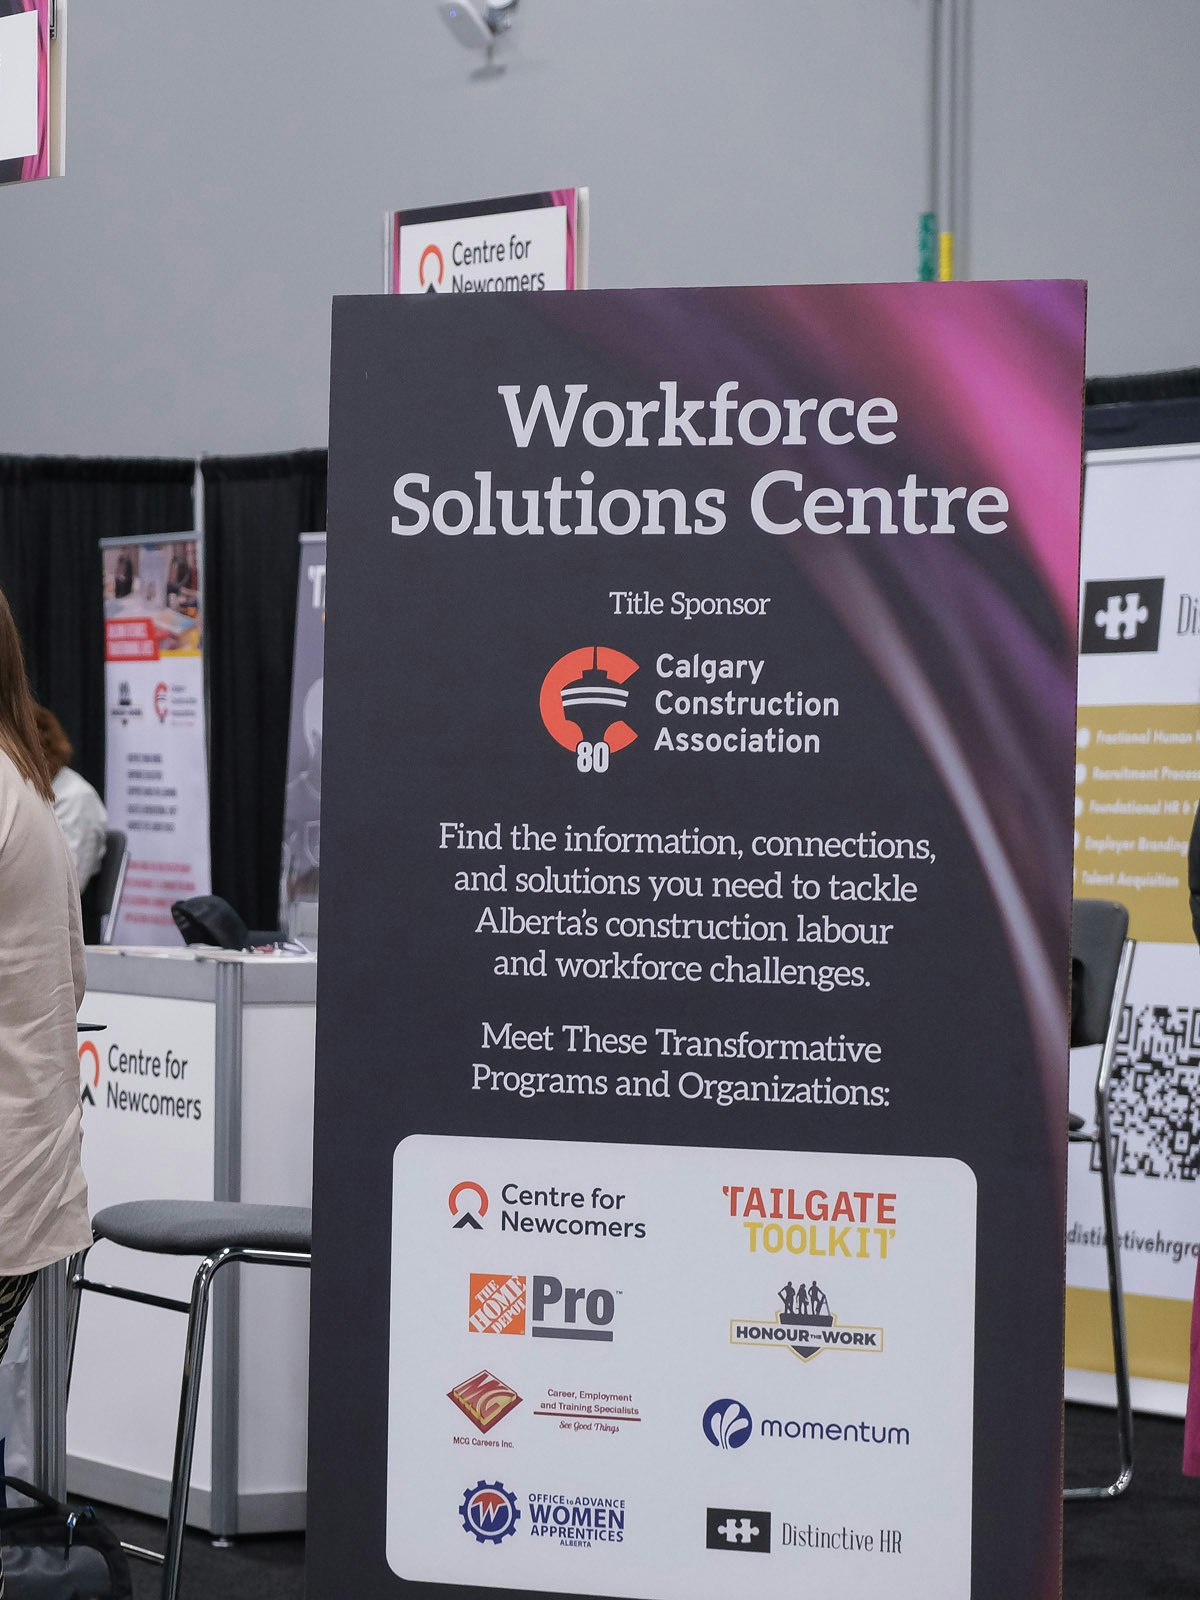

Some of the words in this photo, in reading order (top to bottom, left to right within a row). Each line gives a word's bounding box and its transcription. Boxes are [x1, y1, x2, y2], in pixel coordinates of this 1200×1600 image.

[452, 240, 505, 267] Centre
[509, 234, 532, 260] for
[497, 380, 898, 448] Workforce
[391, 470, 727, 536] Solutions
[750, 469, 1009, 535] Centre
[609, 591, 664, 616] Title
[670, 591, 771, 620] Sponsor
[1177, 593, 1200, 636] Di
[655, 653, 765, 685] Calgary
[655, 689, 839, 717] Construction
[653, 726, 820, 754] Association
[576, 740, 610, 773] 80
[439, 822, 502, 850] Find
[510, 823, 557, 852] the
[564, 824, 744, 861] information,
[751, 830, 937, 865] connections,
[454, 864, 507, 893] and
[515, 866, 641, 896] solutions
[648, 876, 703, 902] you
[711, 871, 783, 899] need
[791, 873, 821, 900] to
[828, 873, 919, 903] tackle
[474, 906, 599, 937] Alberta's
[605, 911, 789, 943] construction
[796, 914, 895, 945] labour
[493, 949, 548, 978] and
[555, 951, 703, 982] workforce
[710, 955, 871, 992] challenges.
[481, 1022, 554, 1051] Meet
[562, 1024, 648, 1055] These
[655, 1028, 883, 1064] Transformative
[107, 1043, 161, 1078] Centre
[165, 1049, 189, 1080] for
[107, 1080, 202, 1121] Newcomers
[471, 1063, 608, 1098] Programs
[615, 1070, 671, 1098] and
[678, 1071, 890, 1107] Organizations:
[501, 1182, 585, 1209] Centre
[591, 1187, 626, 1210] for
[501, 1210, 647, 1239] Newcomers
[1067, 1221, 1200, 1263] distitivehrgro
[469, 1276, 526, 1333] HOME
[474, 1279, 500, 1304] THE
[532, 1275, 615, 1326] Pro
[491, 1297, 526, 1334] DEPOT
[736, 1325, 810, 1343] HONOUR
[822, 1330, 877, 1347] WORK
[540, 1401, 557, 1410] and
[558, 1401, 593, 1413] Training
[594, 1404, 640, 1415] Specialists
[547, 1388, 578, 1400] Career,
[579, 1390, 633, 1402] Employment
[453, 1436, 470, 1446] MCG
[471, 1437, 500, 1448] Careers
[501, 1439, 515, 1449] Inc.
[559, 1420, 573, 1430] See
[573, 1421, 593, 1432] Good
[594, 1422, 620, 1434] Things
[761, 1419, 910, 1446] momentum
[528, 1493, 565, 1505] OFFICE
[574, 1496, 626, 1509] ADVANCE
[528, 1503, 625, 1530] WOMEN
[530, 1524, 624, 1543] APPRENTICES
[559, 1539, 592, 1548] ALBERTA
[782, 1522, 874, 1552] Distinctive
[880, 1529, 902, 1553] HR
